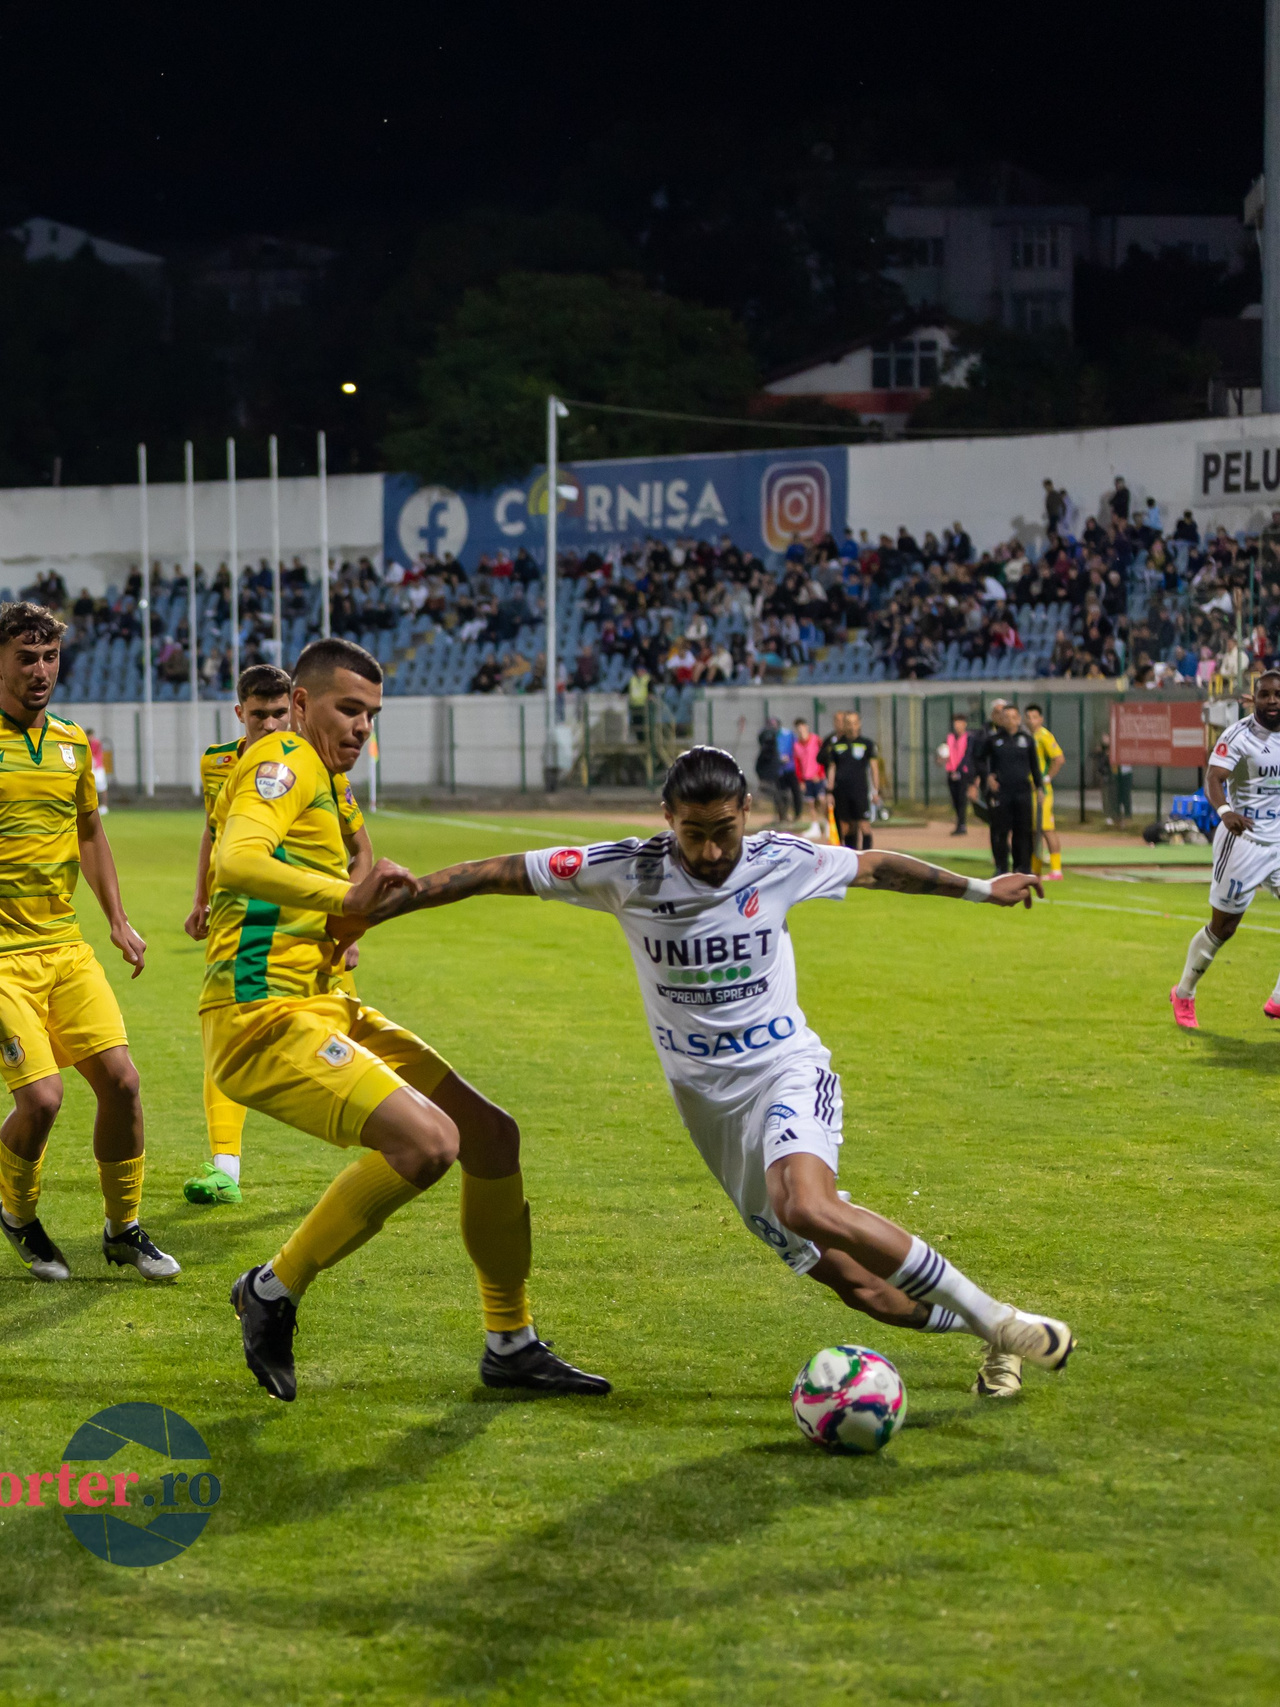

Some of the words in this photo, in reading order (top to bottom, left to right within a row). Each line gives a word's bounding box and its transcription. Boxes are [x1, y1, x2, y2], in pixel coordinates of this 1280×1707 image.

[1202, 448, 1280, 495] PELU
[1243, 806, 1280, 820] ELS
[643, 929, 772, 966] UNIBET
[715, 987, 744, 1002] SPRE
